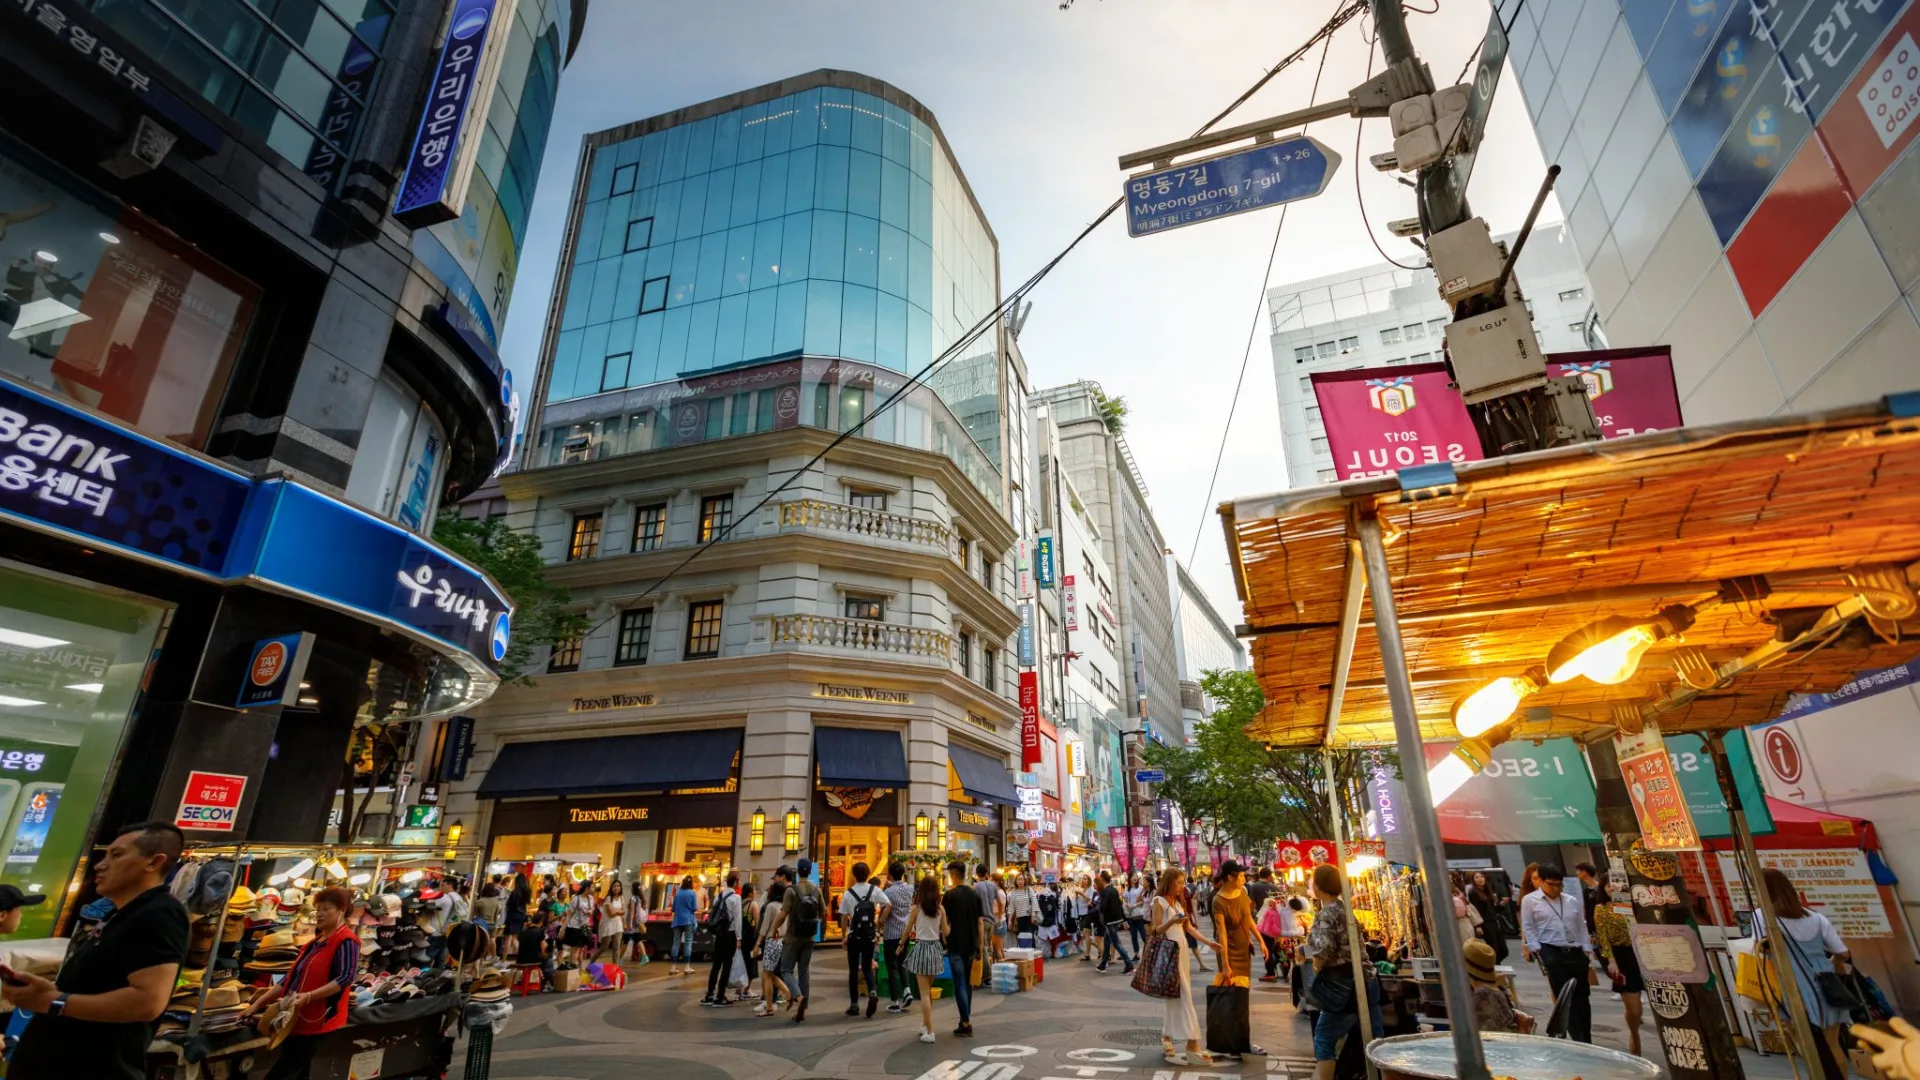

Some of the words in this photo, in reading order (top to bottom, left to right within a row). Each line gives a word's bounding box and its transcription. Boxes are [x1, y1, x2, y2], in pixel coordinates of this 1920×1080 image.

[420, 44, 474, 168] 우리은행
[1294, 148, 1311, 161] 26
[1131, 165, 1208, 199] 명동7길
[1134, 182, 1239, 216] Myeongdong
[1242, 172, 1281, 191] 7-gil
[1479, 323, 1493, 332] LG
[1494, 317, 1508, 327] U+
[261, 655, 279, 668] TAX
[257, 667, 276, 677] FREE
[818, 683, 864, 700] TEENIE
[863, 687, 909, 704] WEENIE
[1023, 686, 1034, 704] the
[573, 697, 612, 711] TEENIE
[612, 694, 654, 708] WEENIE
[1024, 706, 1037, 747] SAEM
[200, 790, 228, 802] 에스원
[182, 806, 233, 820] SECOM
[570, 808, 608, 822] TEENIE
[607, 806, 649, 820] WEENIE
[958, 809, 974, 823] TEENIE
[973, 812, 989, 827] WEENIE
[1377, 789, 1396, 834] HOLIKA
